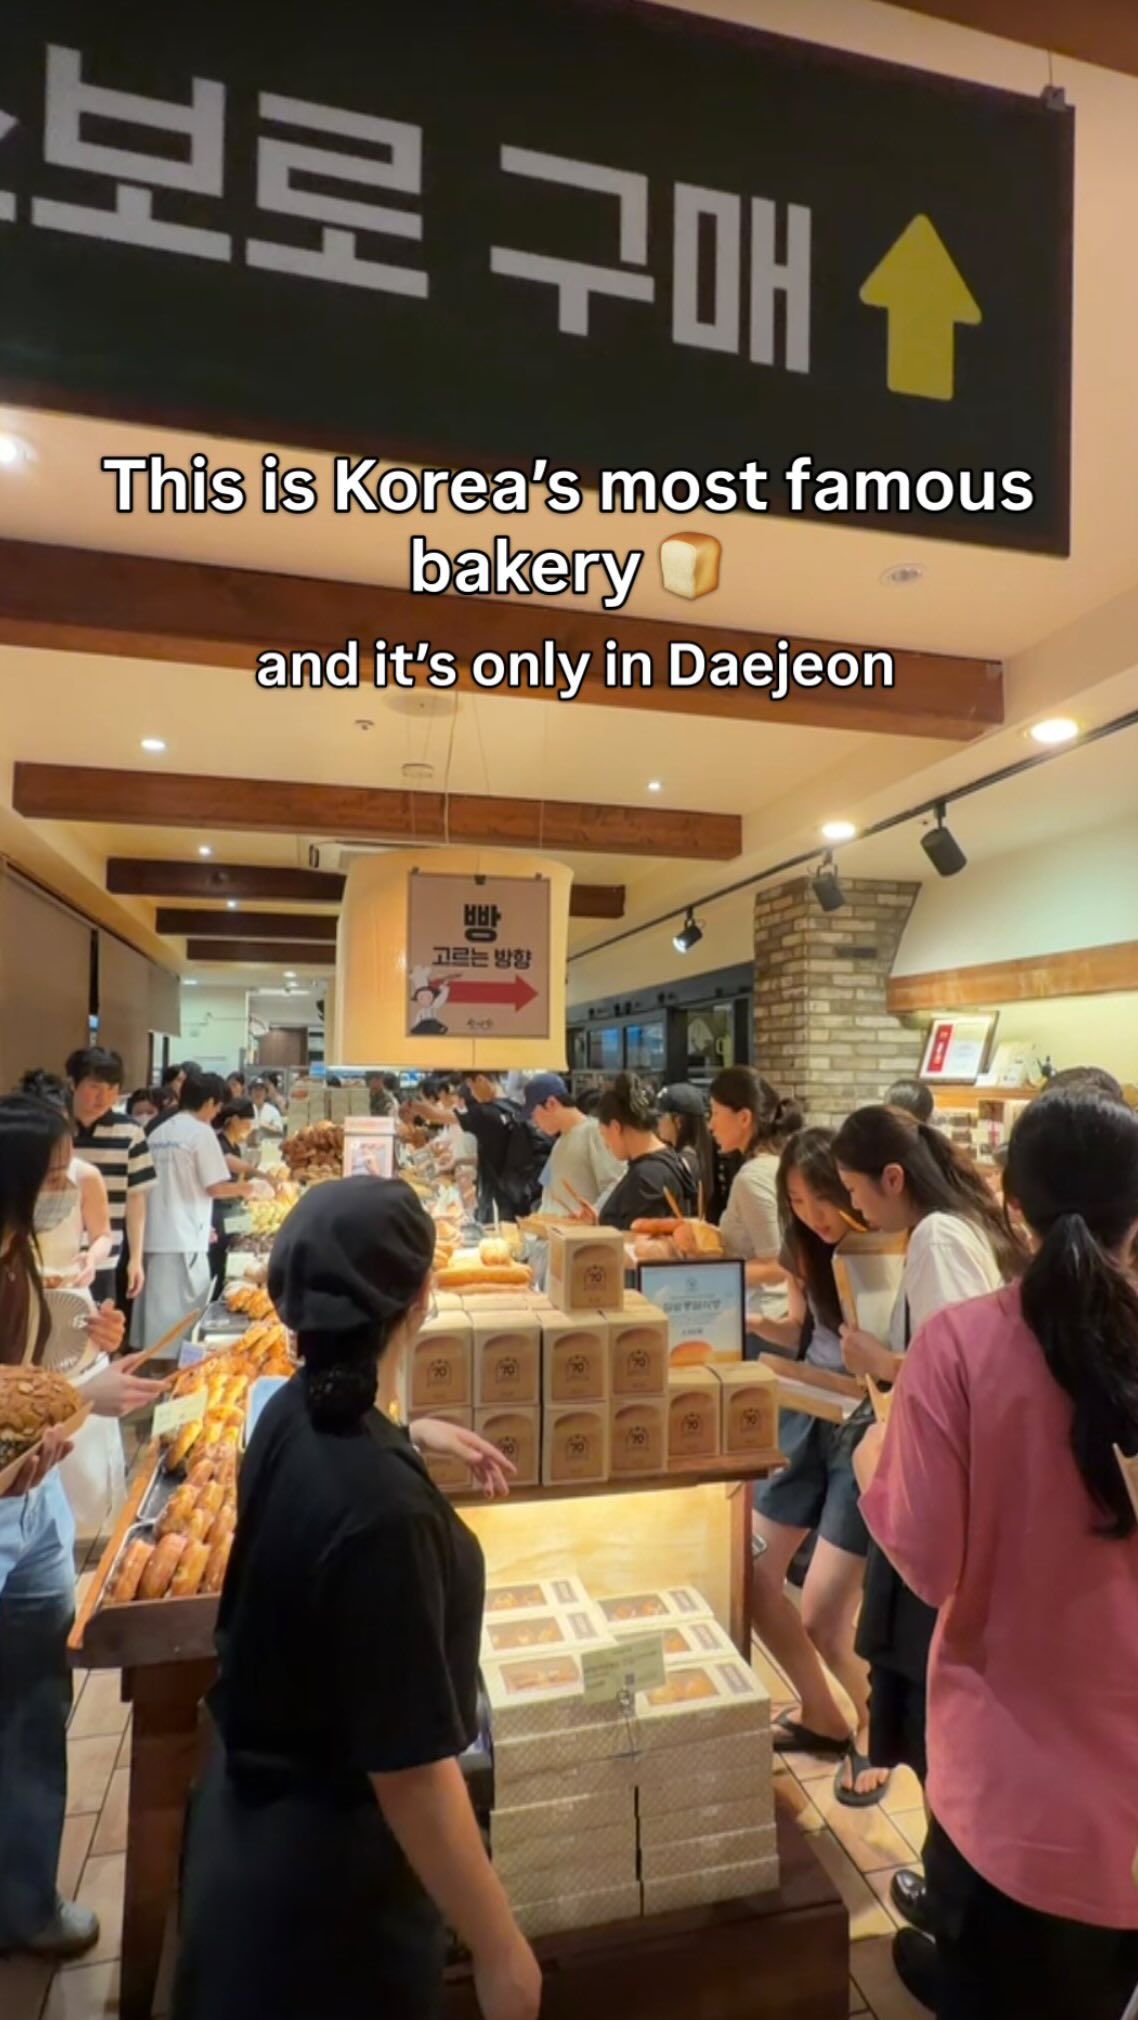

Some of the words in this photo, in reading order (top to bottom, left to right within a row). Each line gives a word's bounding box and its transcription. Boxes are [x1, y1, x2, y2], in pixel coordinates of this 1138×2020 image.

[491, 146, 811, 373] 구매
[464, 904, 501, 943] 빵
[432, 946, 489, 968] 고르는
[494, 948, 531, 970] 방향
